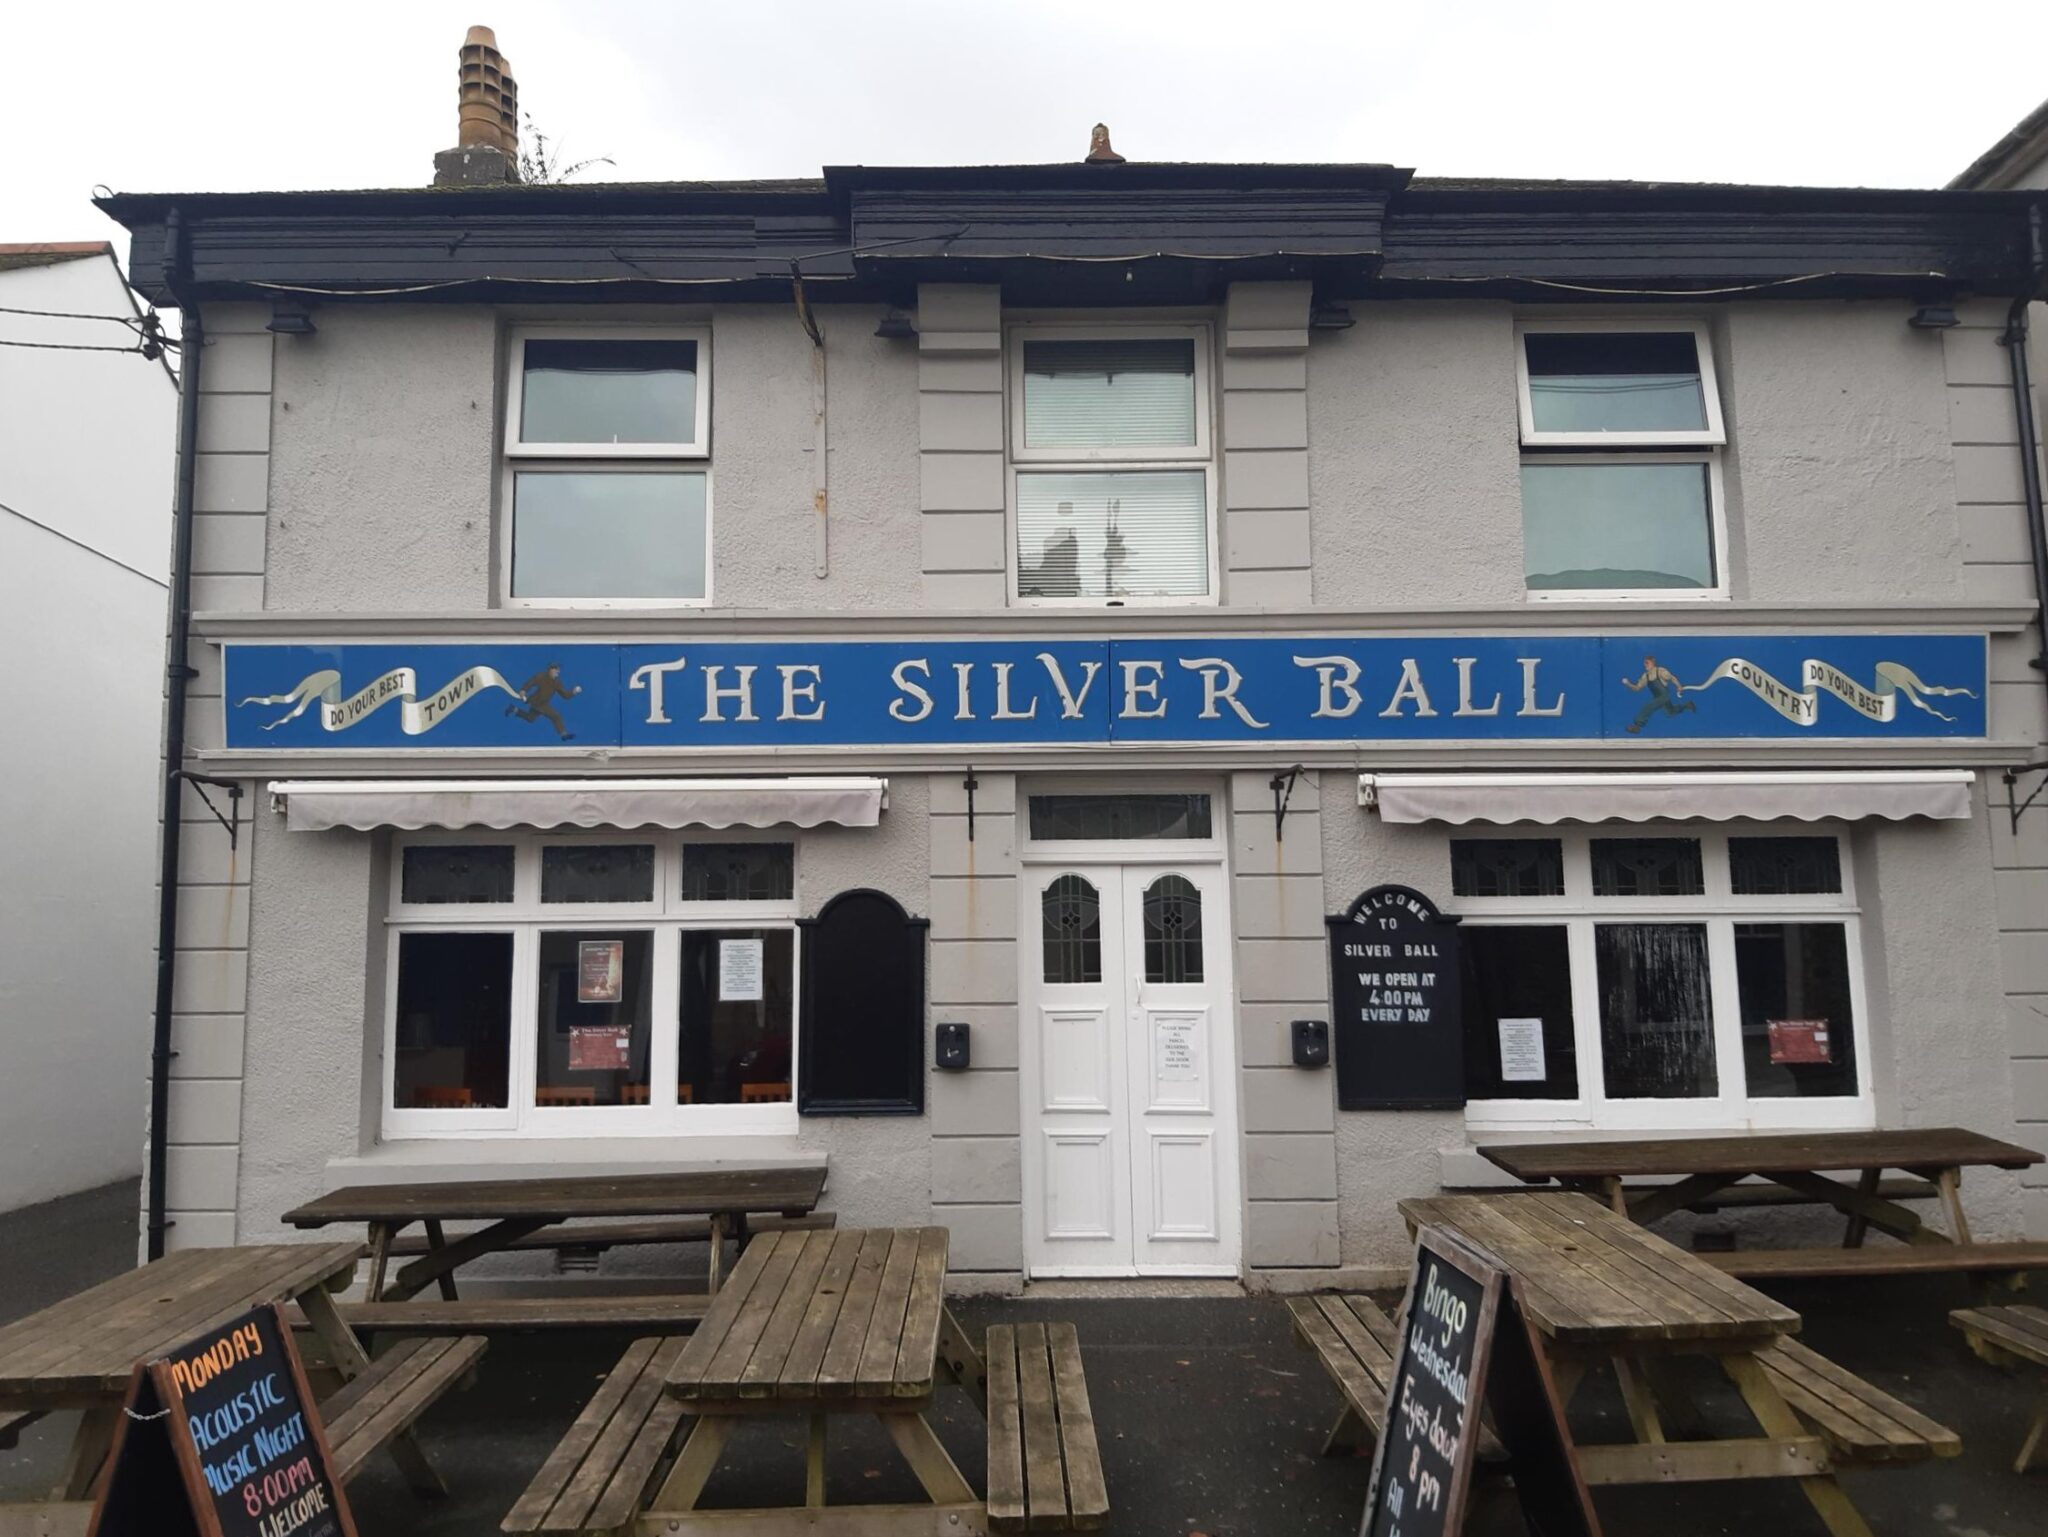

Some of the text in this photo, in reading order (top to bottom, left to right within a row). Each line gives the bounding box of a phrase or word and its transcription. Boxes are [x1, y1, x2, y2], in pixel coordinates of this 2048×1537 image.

[330, 673, 405, 726] DO YOUR BEST
[424, 674, 475, 721] TOWN
[629, 652, 1565, 728] THE SILVER BALL
[1731, 663, 1814, 718] COUNTRY
[1810, 664, 1885, 717] DO YOUR BEST
[1353, 893, 1430, 925] WELCOME
[1379, 918, 1397, 930] TO
[1344, 944, 1438, 957] SILVER BALL
[1358, 973, 1436, 986] WE OPEN AT
[1404, 991, 1423, 1006] PM
[1361, 1008, 1430, 1022] EVERY DAY
[1423, 1263, 1468, 1348] Bingo
[171, 1322, 263, 1399] MONDAY
[189, 1372, 285, 1455] ACOUSTIC
[1401, 1373, 1430, 1440] Eyes
[203, 1411, 305, 1496] MUSIC NIGHT
[1409, 1444, 1440, 1511] 8 pm
[259, 1482, 329, 1537] WELCOME
